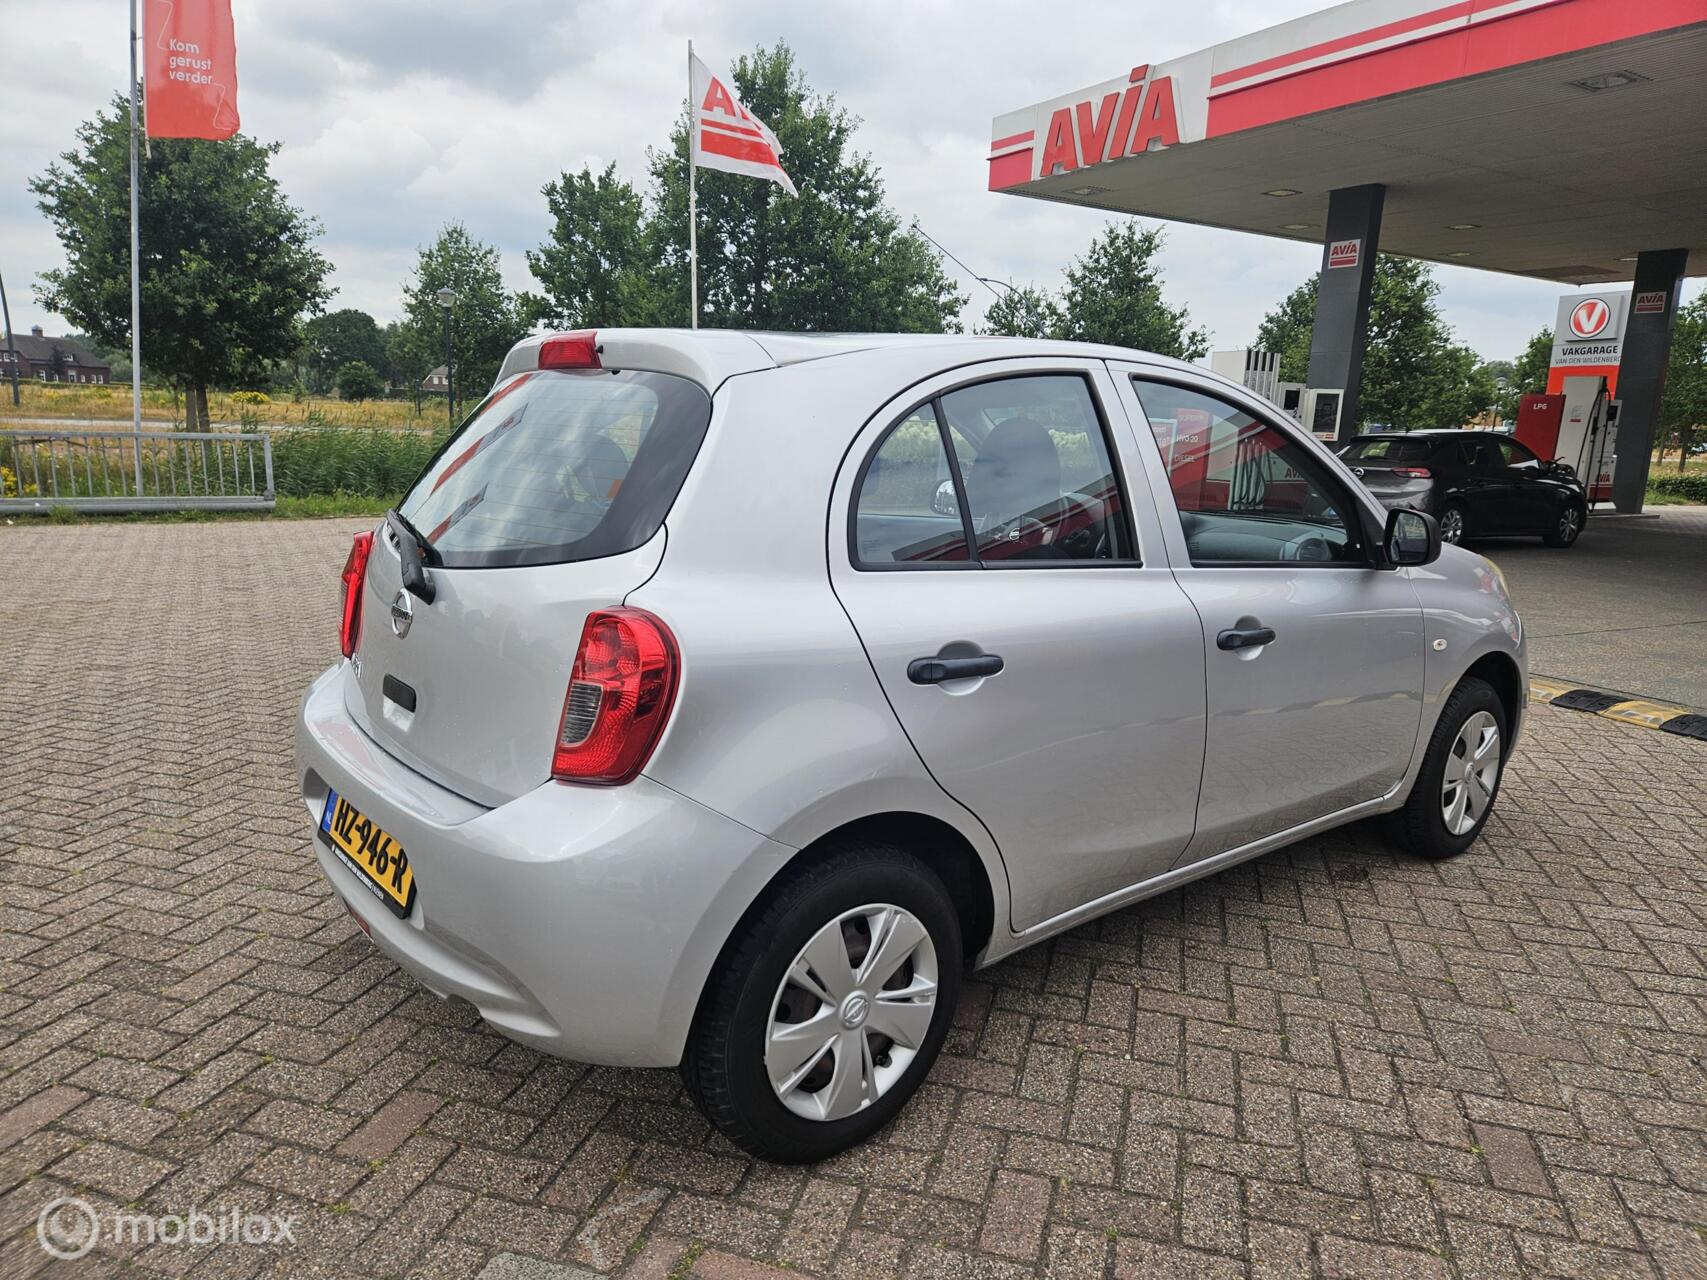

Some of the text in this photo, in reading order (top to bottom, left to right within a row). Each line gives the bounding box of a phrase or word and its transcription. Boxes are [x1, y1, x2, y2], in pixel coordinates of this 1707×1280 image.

[169, 39, 199, 54] Kom
[169, 56, 212, 70] gerust
[169, 70, 213, 85] verder
[1562, 345, 1618, 356] VAKGARAGE
[334, 797, 409, 895] HZ-946-R
